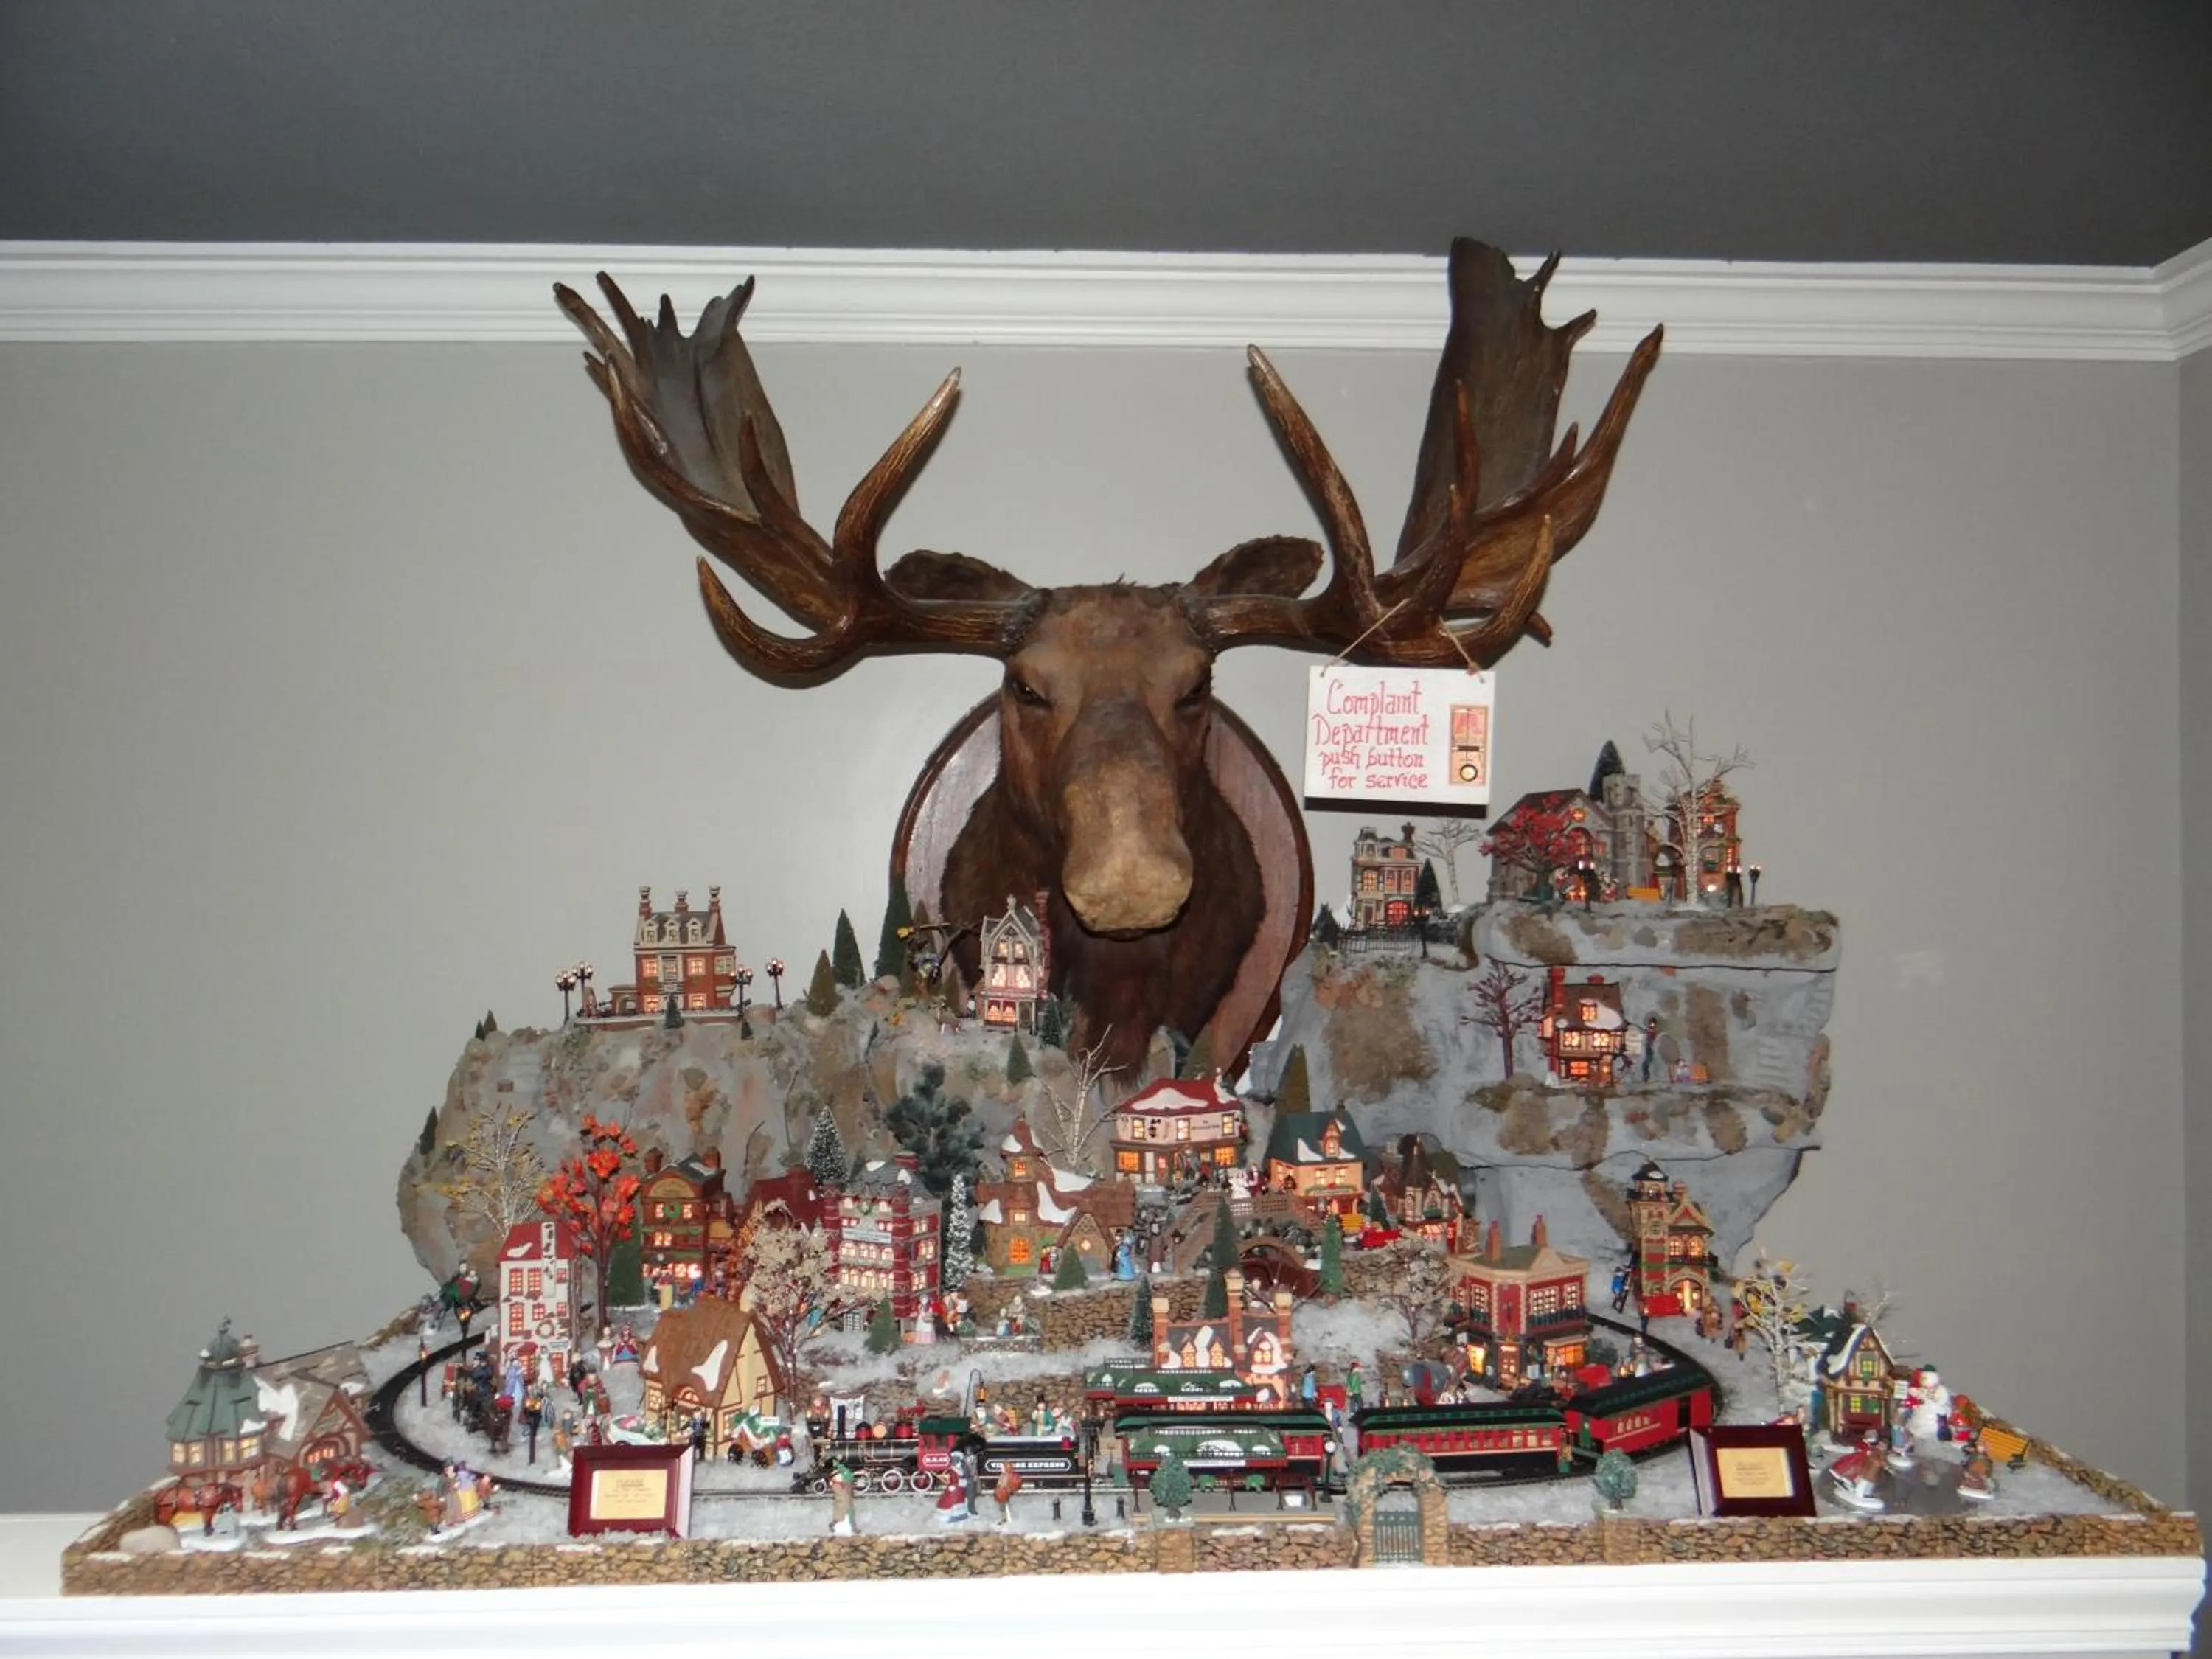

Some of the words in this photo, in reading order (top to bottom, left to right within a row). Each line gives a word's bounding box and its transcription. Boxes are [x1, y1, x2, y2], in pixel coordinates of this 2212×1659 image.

[1312, 713, 1429, 751] Department
[1318, 745, 1360, 775] push
[1366, 746, 1425, 770] button
[1329, 766, 1357, 789] for
[1366, 772, 1428, 789] service
